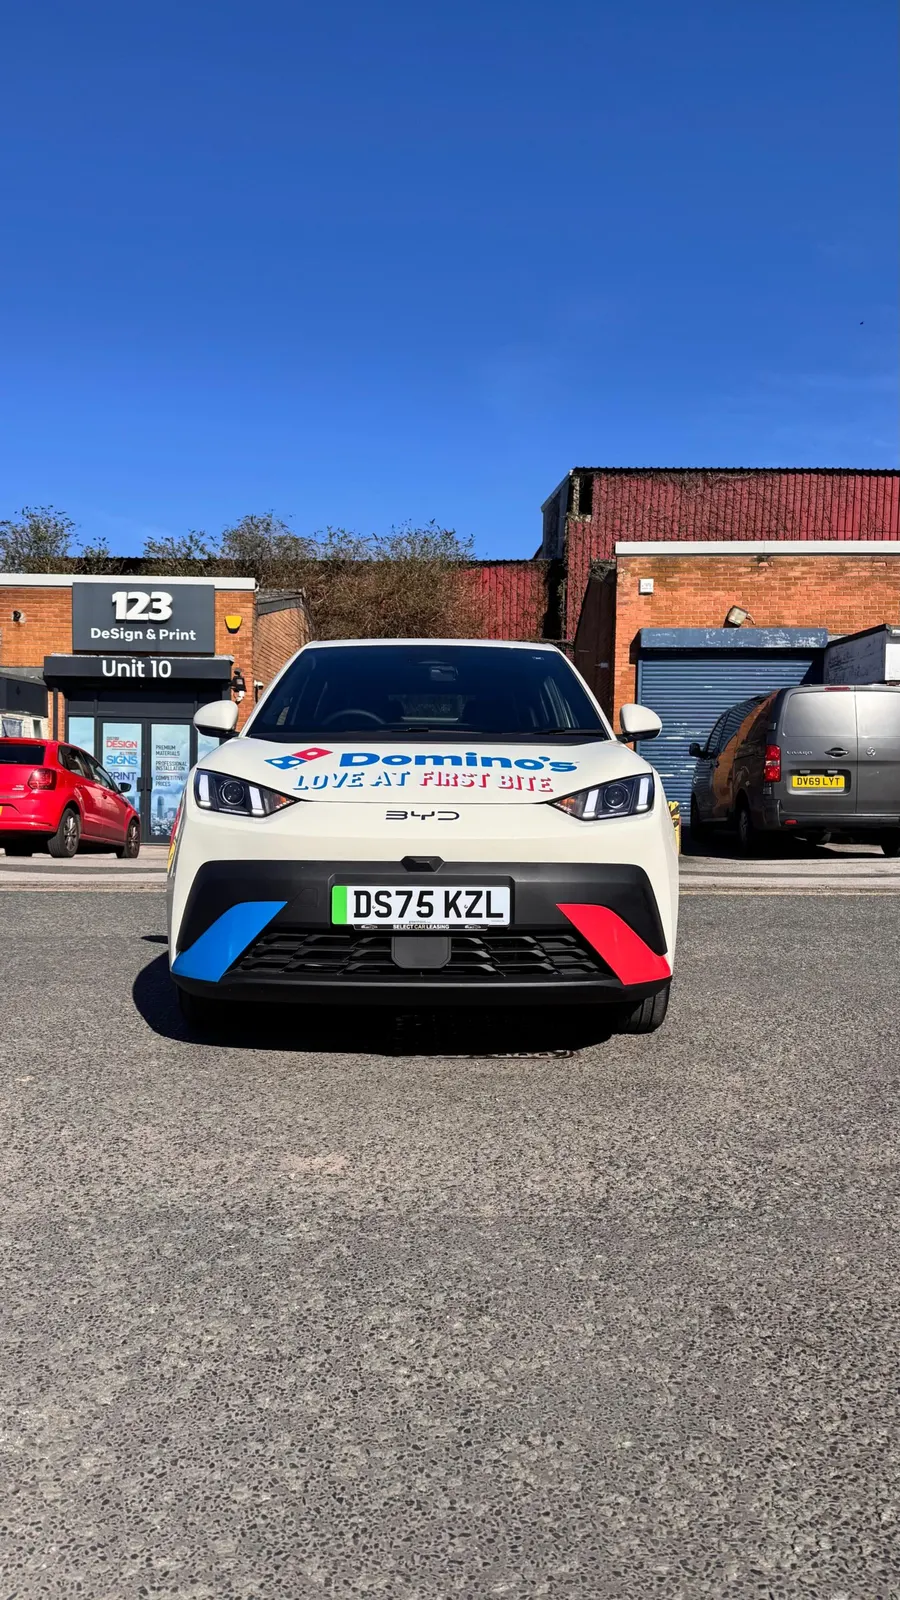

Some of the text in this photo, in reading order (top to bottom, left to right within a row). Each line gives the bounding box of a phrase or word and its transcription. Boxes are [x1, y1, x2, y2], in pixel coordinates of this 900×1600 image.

[111, 591, 173, 622] 123
[90, 627, 197, 642] DeSign & Print
[102, 659, 172, 678] Unit 10
[106, 755, 138, 765] SIGNS
[339, 752, 578, 772] Domino's
[108, 772, 137, 780] PRINT
[292, 770, 554, 793] LOVE AT FIRST BITE
[797, 777, 840, 786] DV69 LYT
[385, 810, 460, 821] BYD
[353, 890, 504, 919] DS75 KZL
